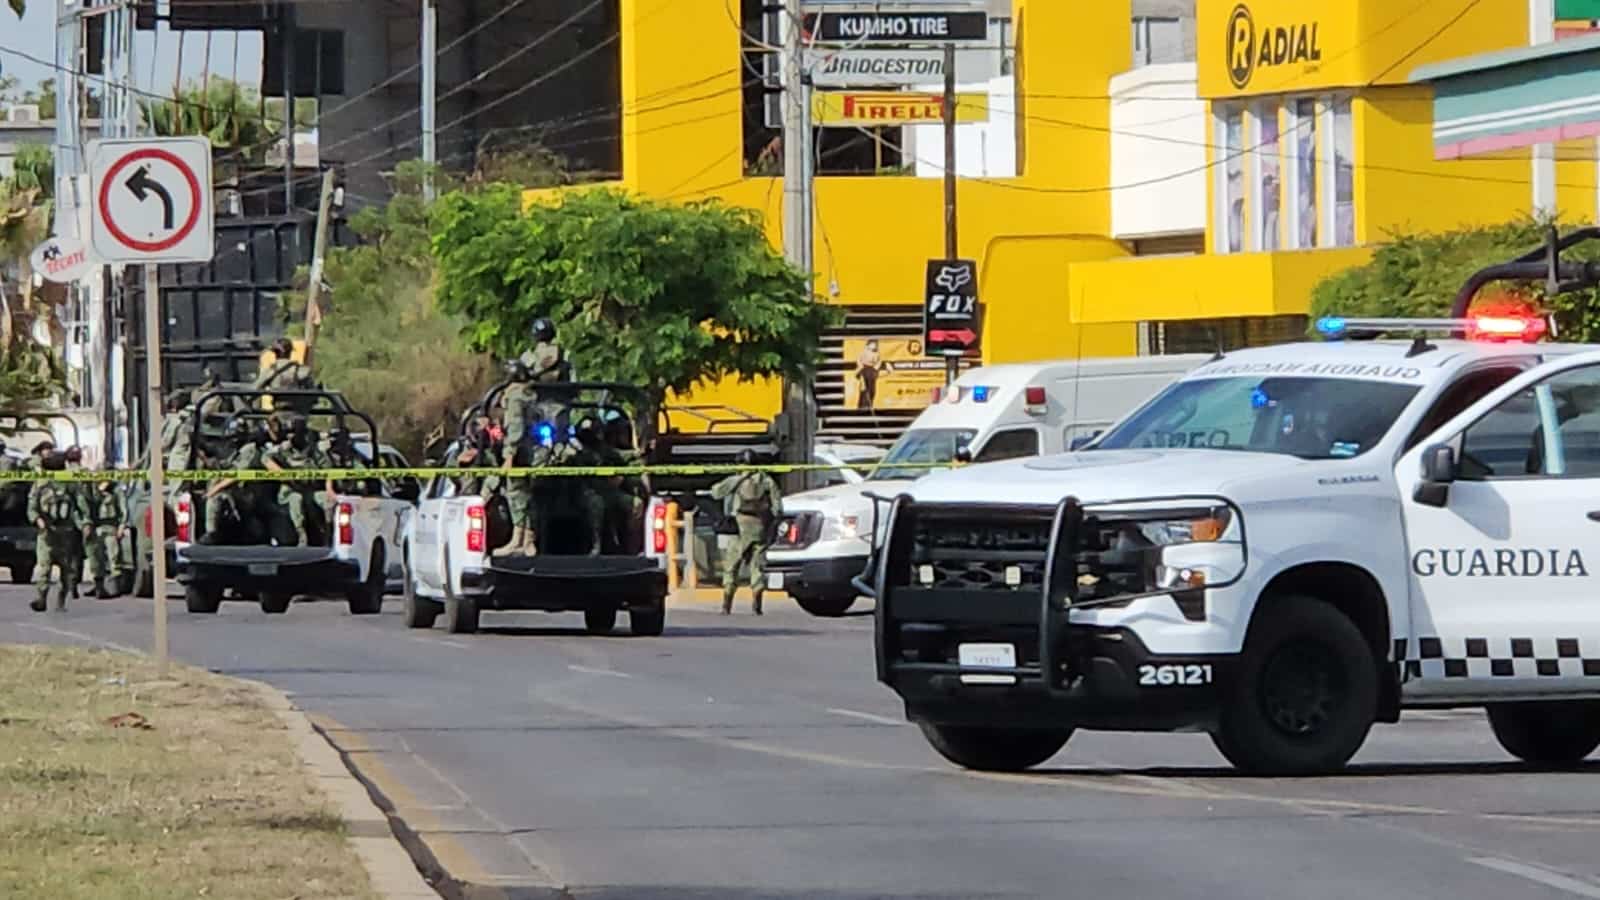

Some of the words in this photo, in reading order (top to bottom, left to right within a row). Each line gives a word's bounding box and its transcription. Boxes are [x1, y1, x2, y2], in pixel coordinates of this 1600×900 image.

[839, 17, 907, 36] KUMHO
[909, 17, 948, 35] TIRE
[823, 55, 945, 75] BRIDGESTON
[929, 294, 976, 313] FOX
[1412, 548, 1589, 577] GUARDIA
[1139, 665, 1212, 685] 26121
